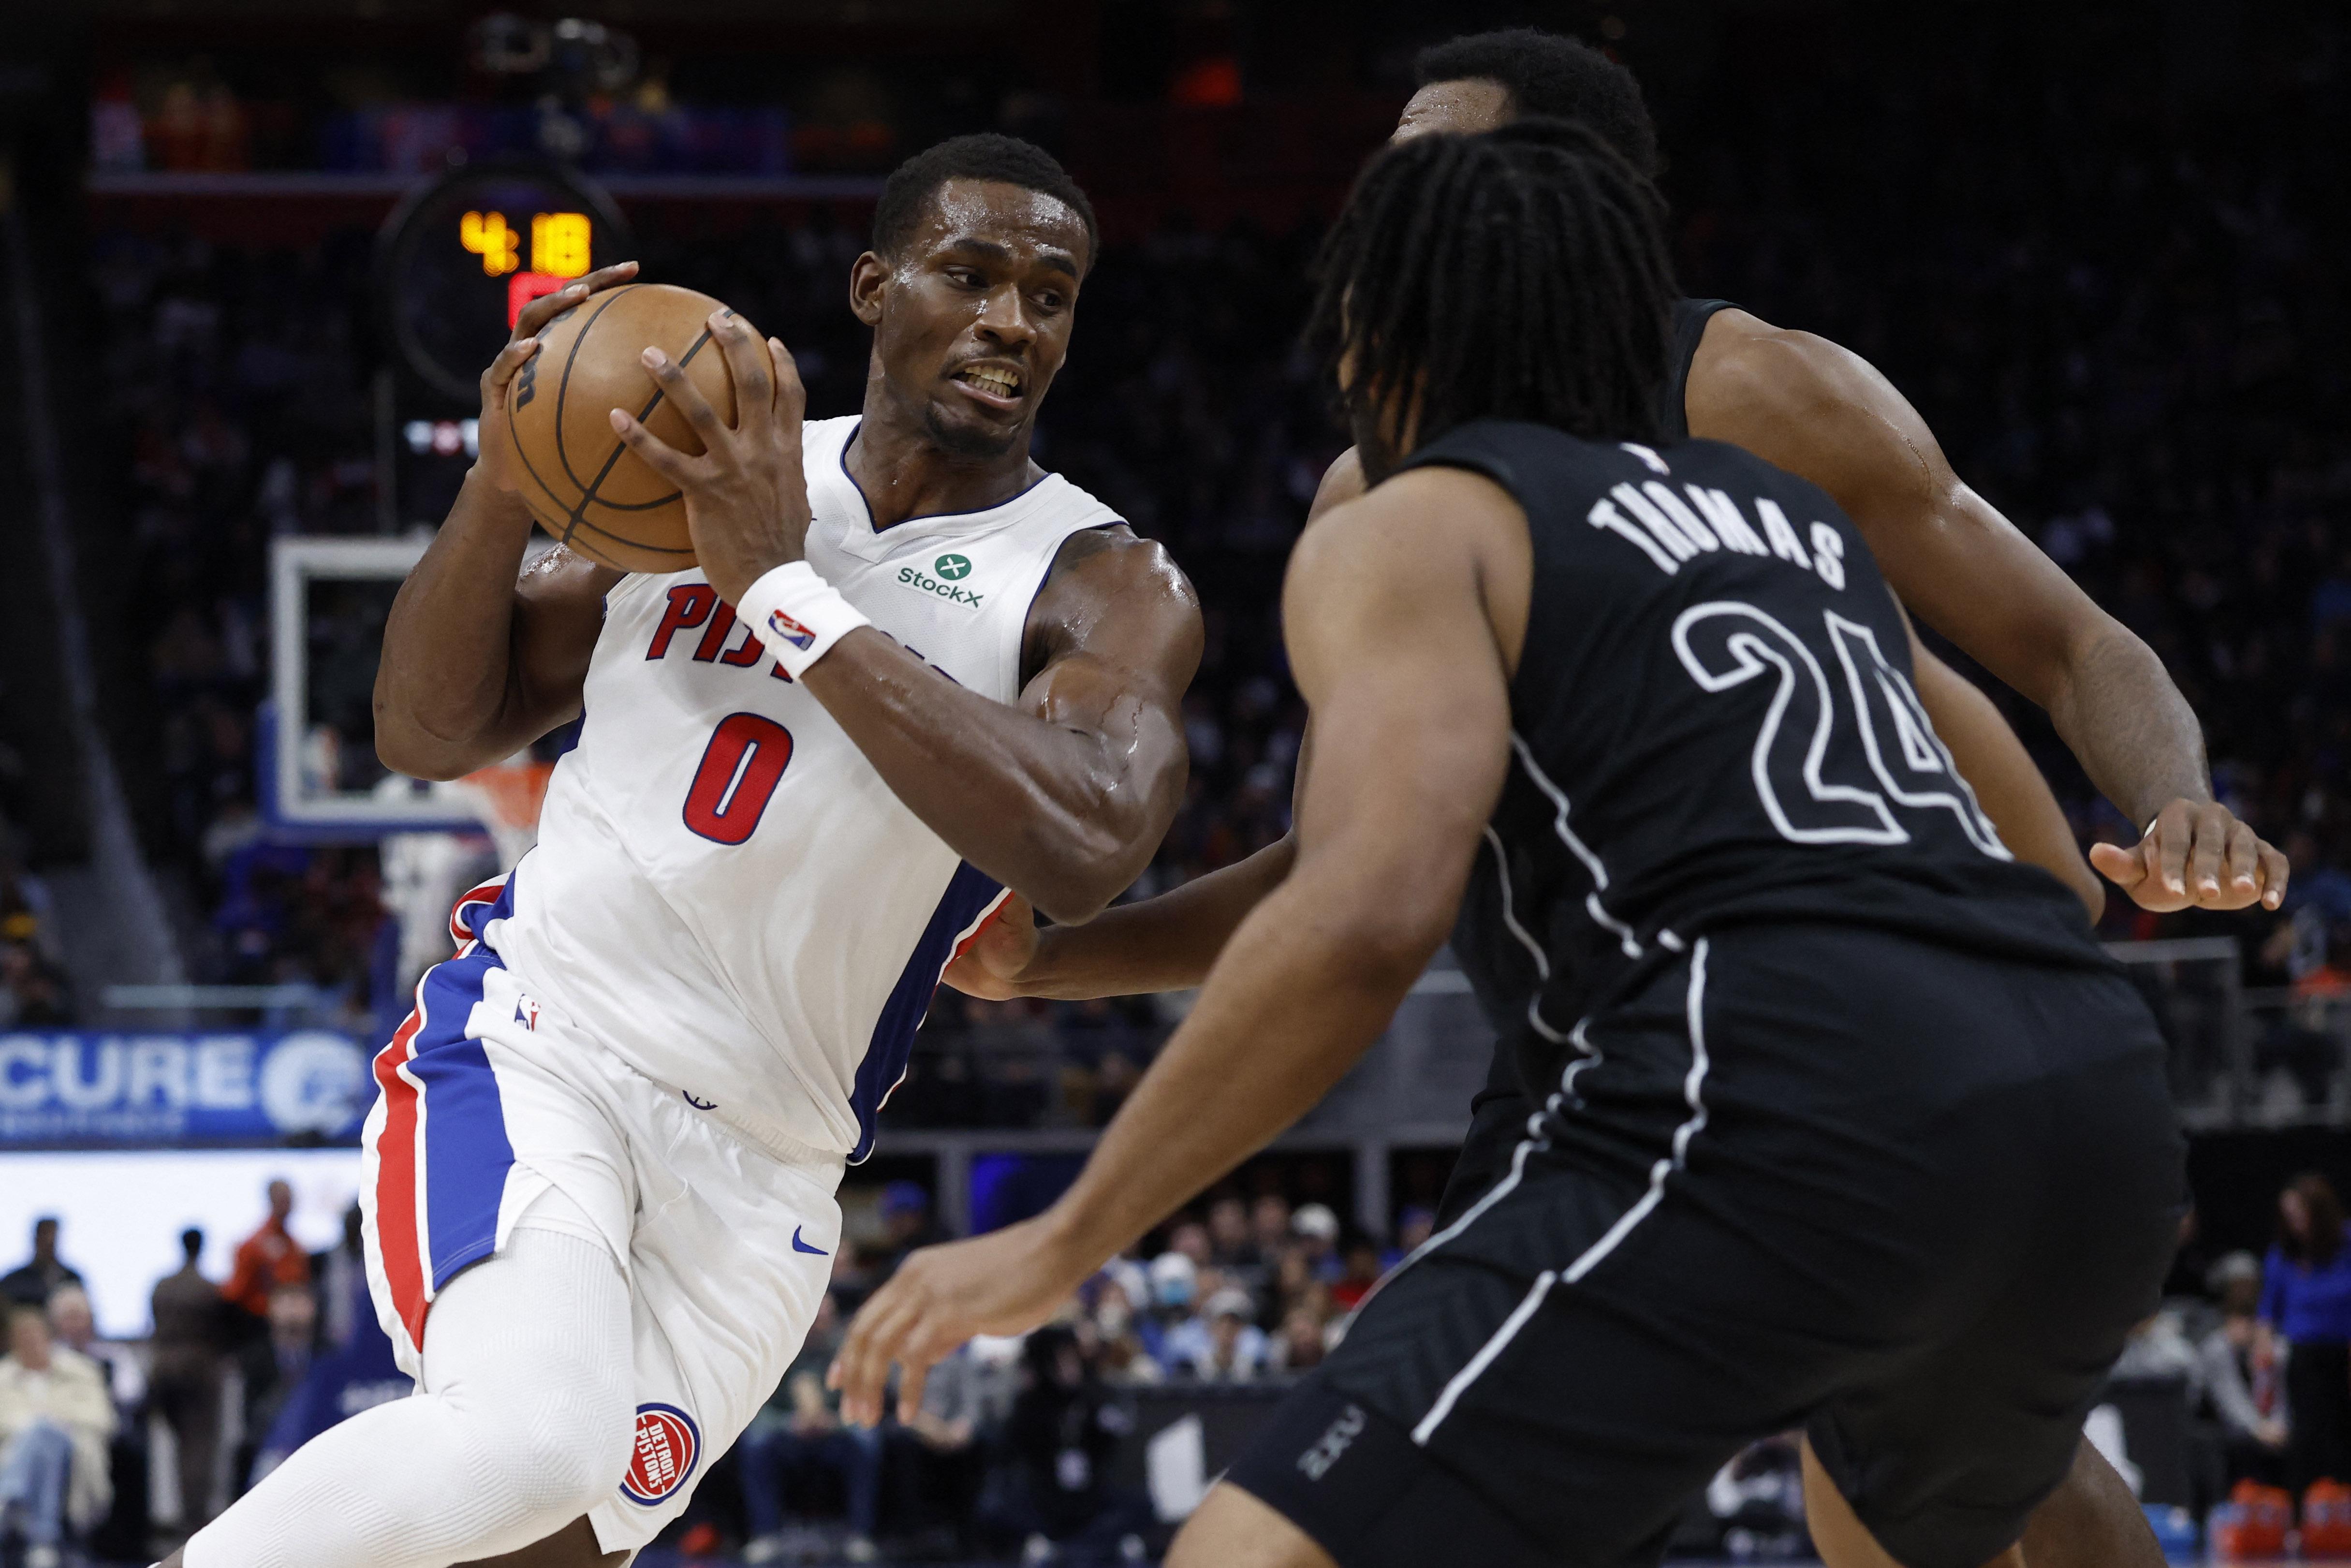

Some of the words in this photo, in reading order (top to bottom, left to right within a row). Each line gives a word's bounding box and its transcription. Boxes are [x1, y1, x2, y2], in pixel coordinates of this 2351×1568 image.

[1587, 481, 1845, 590] THOMAS
[898, 568, 984, 608] StockX
[1671, 601, 2015, 862] 24
[683, 712, 793, 845] 0
[0, 1034, 255, 1111] CURE
[635, 1427, 663, 1489] PISTONS
[648, 1421, 676, 1480] DETROIT
